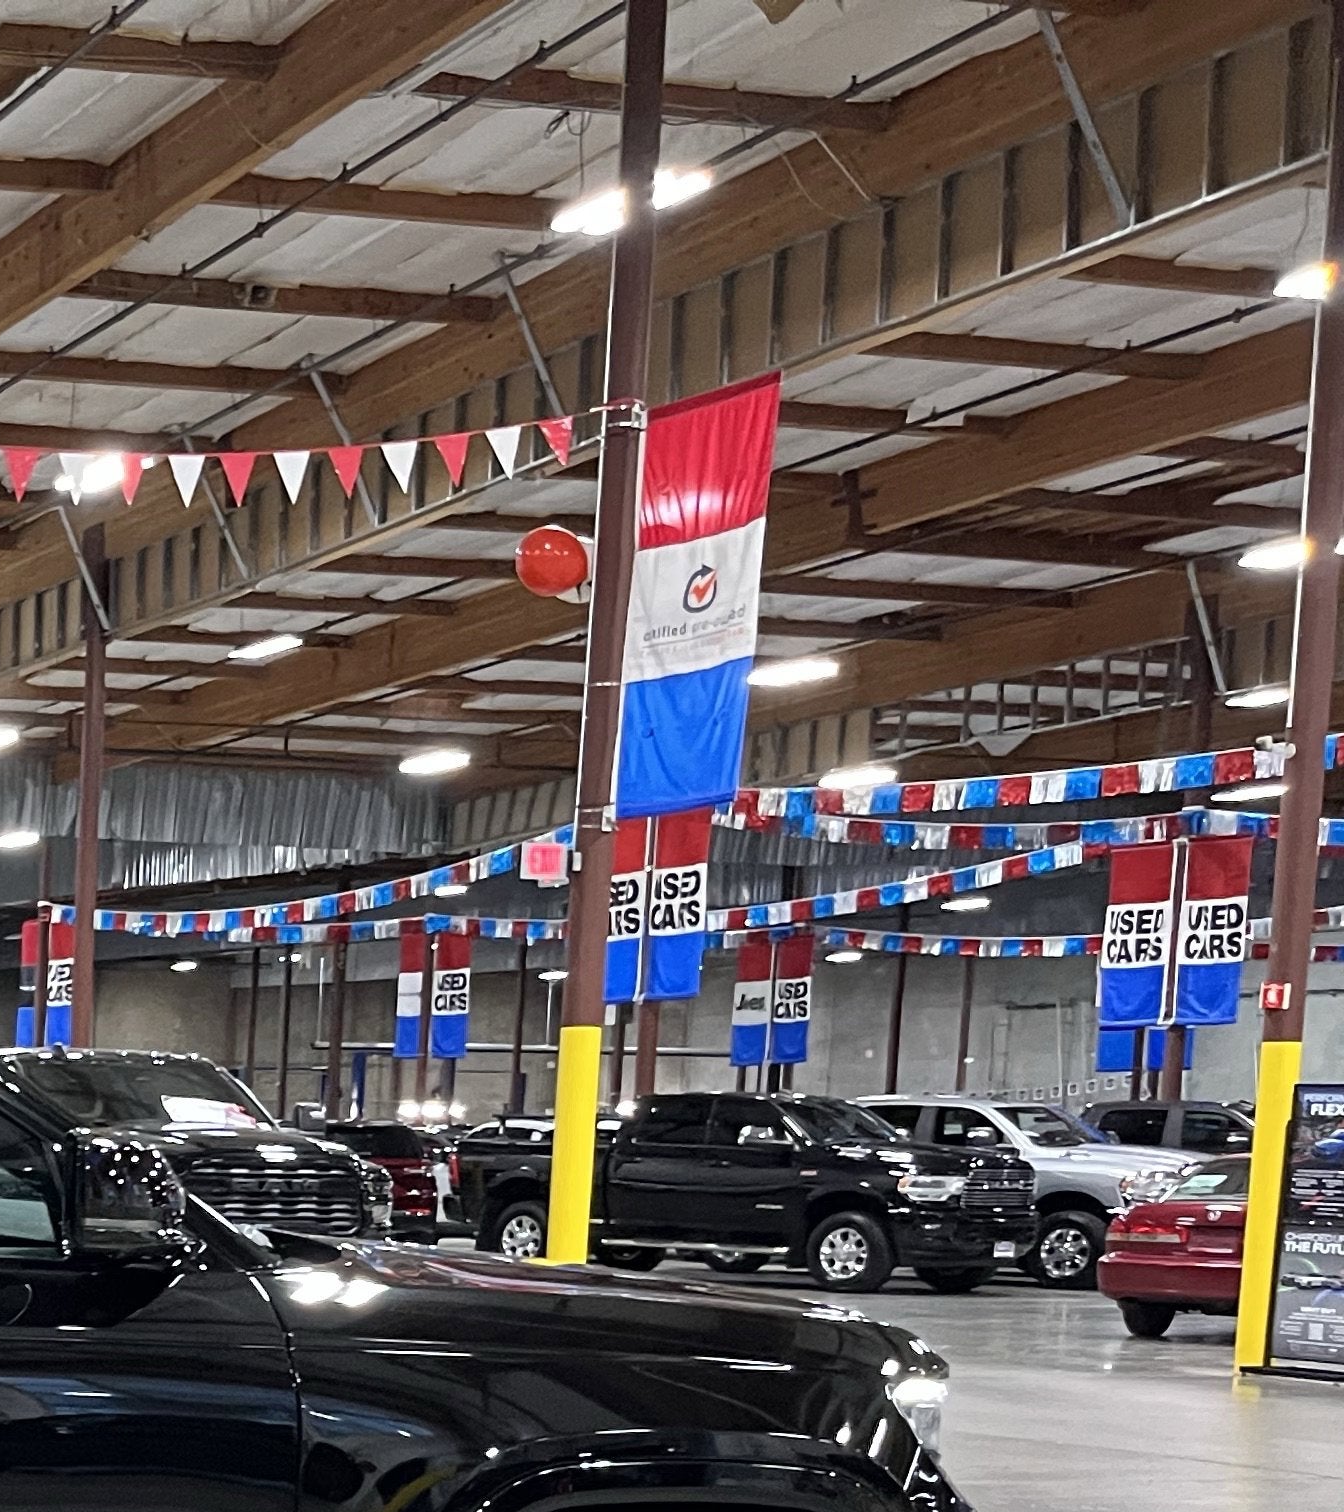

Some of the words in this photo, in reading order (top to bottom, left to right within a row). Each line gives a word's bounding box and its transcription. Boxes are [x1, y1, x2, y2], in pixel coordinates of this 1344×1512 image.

[609, 878, 640, 907] SED
[1110, 908, 1164, 935] USED
[1188, 903, 1244, 931] USED
[1107, 936, 1163, 964] CARS
[1184, 931, 1243, 960] CARS
[1284, 1240, 1310, 1253] THE
